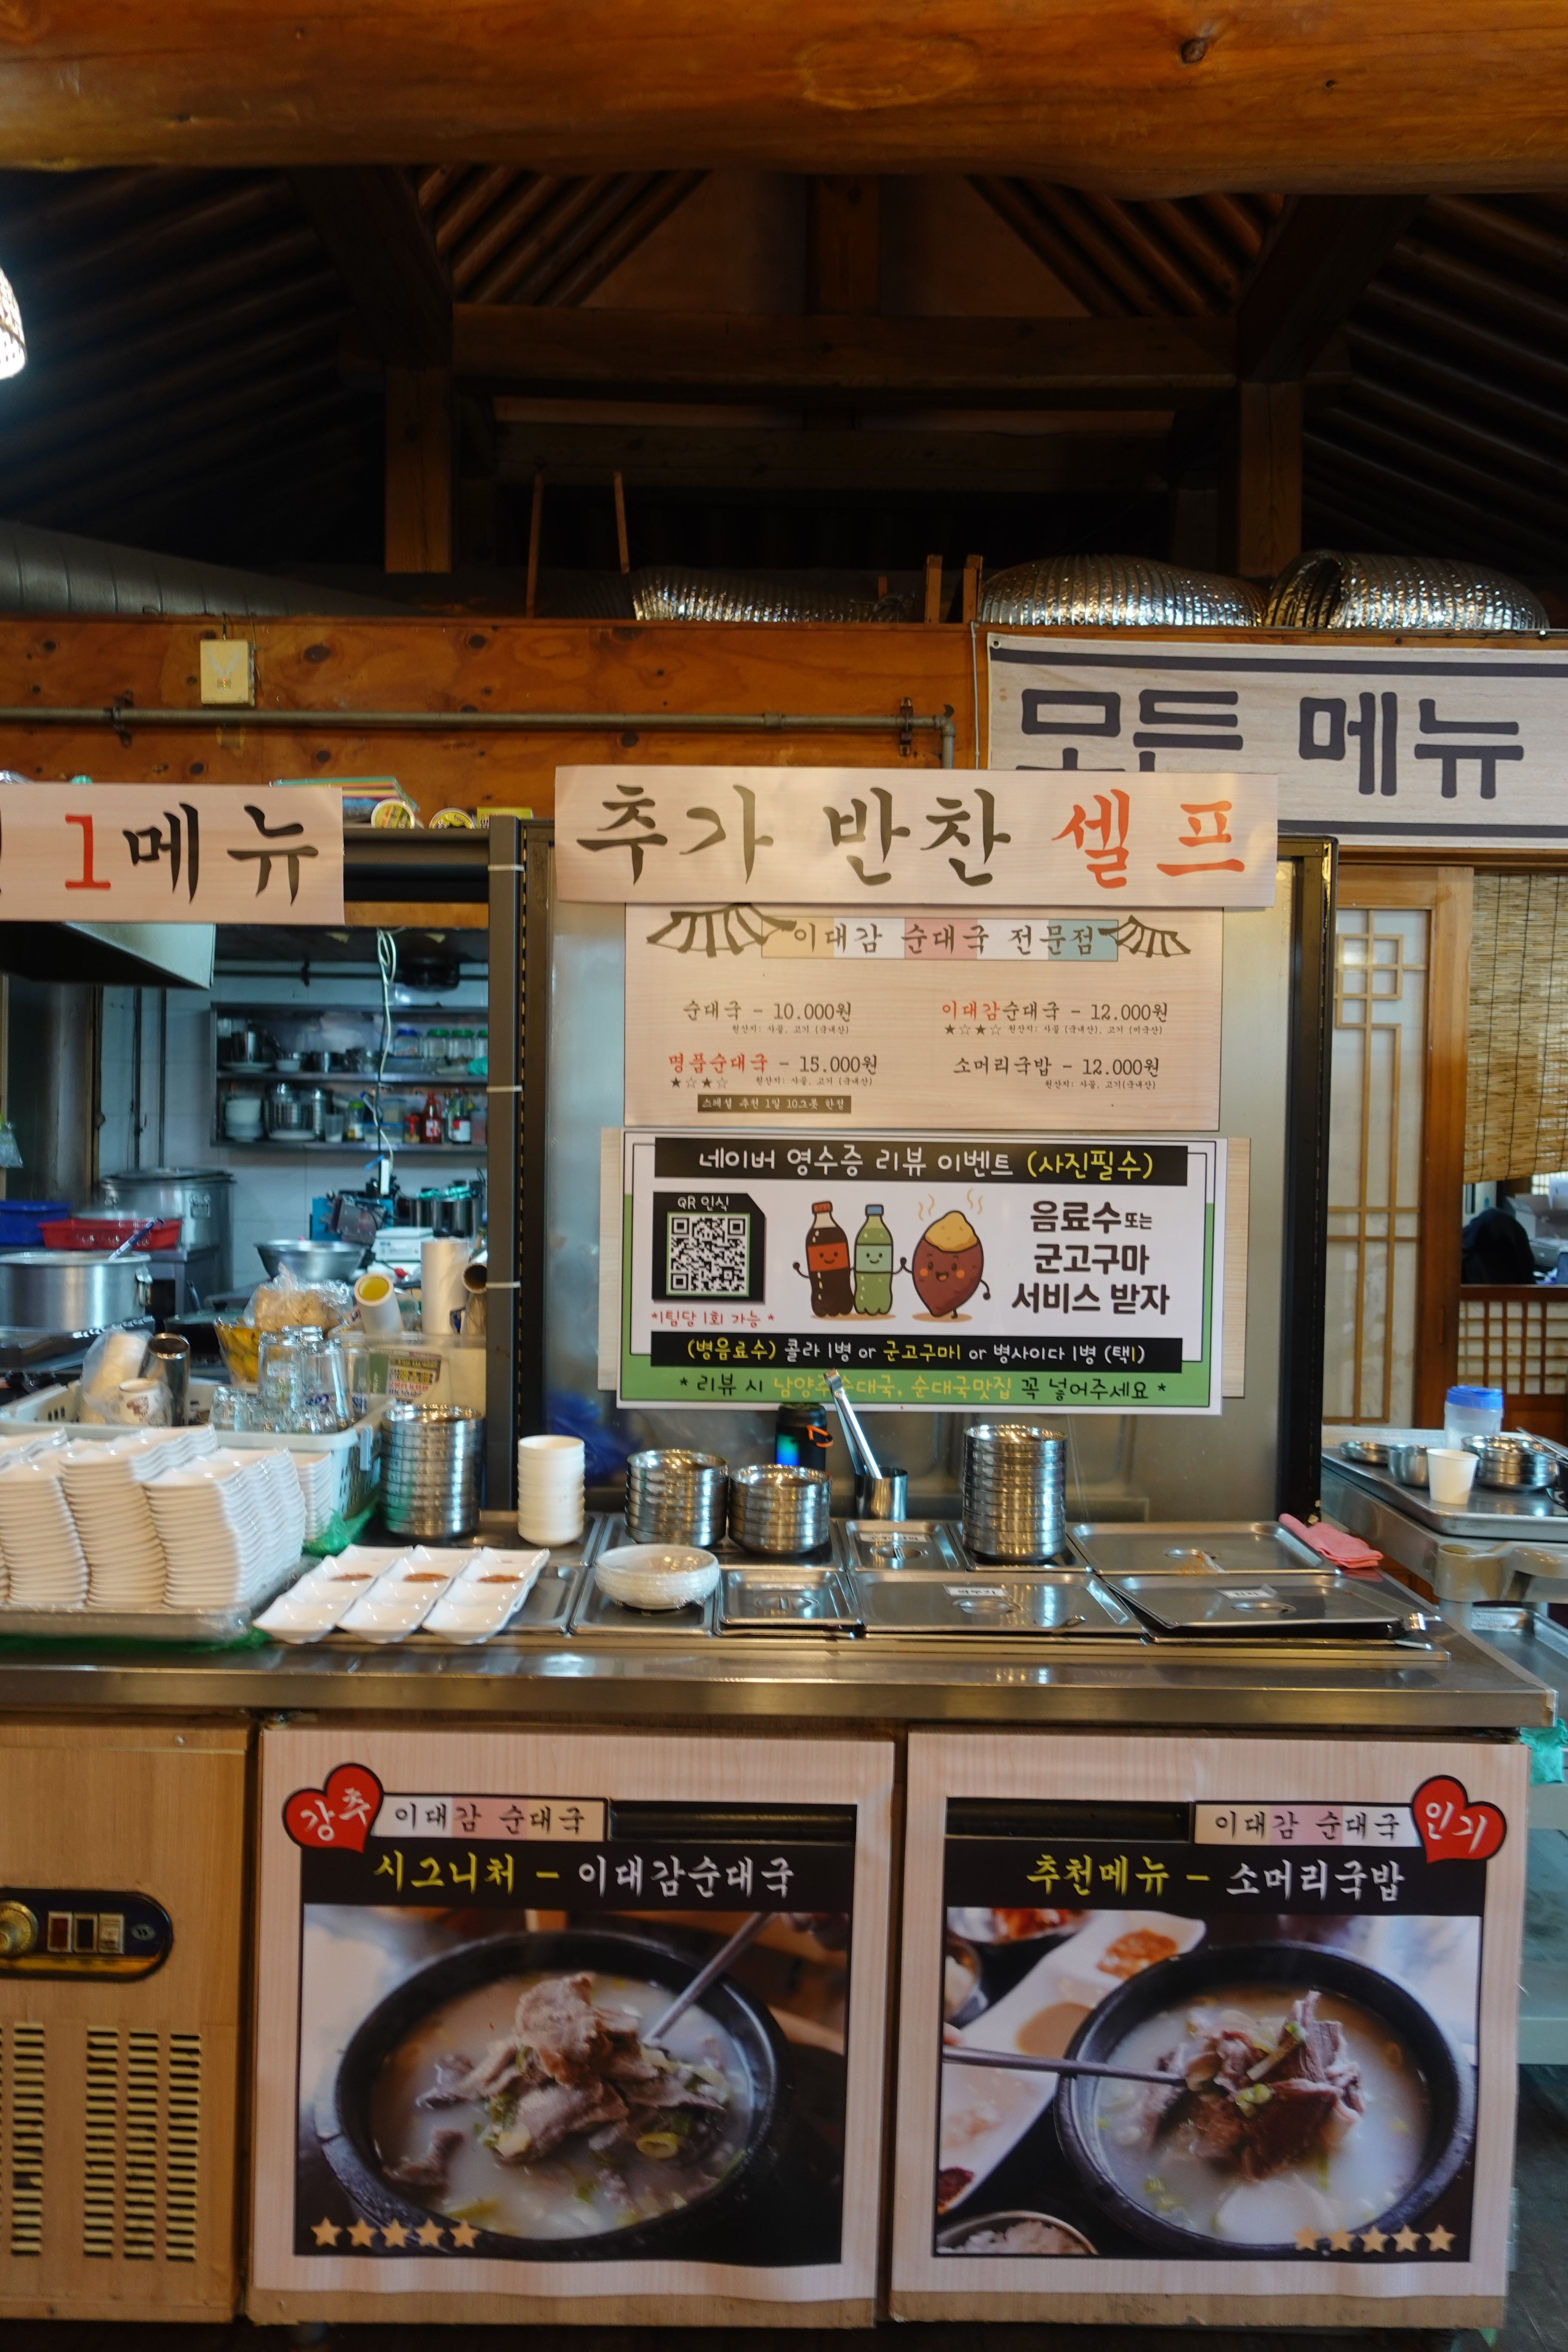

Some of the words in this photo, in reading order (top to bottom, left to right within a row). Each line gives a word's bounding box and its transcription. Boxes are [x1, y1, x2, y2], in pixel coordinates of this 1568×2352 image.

[1296, 690, 1526, 800] 메뉴
[576, 783, 775, 886] 추가
[823, 787, 1012, 887] 반찬
[1051, 787, 1246, 890] 셀프
[793, 922, 882, 954] 이대감
[901, 923, 989, 955] 순대국
[1007, 924, 1094, 956] 전문점
[683, 999, 742, 1021] 순대국
[773, 1001, 852, 1023] 10.000원
[942, 999, 1060, 1022] 이대감순대국
[1090, 1001, 1168, 1023] 12.000원
[668, 1052, 768, 1075] 명품순대국
[799, 1054, 878, 1075] 15.000원
[952, 1055, 1052, 1077] 소머리국밥
[1082, 1057, 1159, 1078] 12.000원
[698, 1146, 775, 1170] 네이버
[786, 1144, 864, 1178] 영수증
[875, 1145, 927, 1177] 리뷰
[937, 1150, 1014, 1179] 이벤트
[1026, 1150, 1154, 1181] (사진필수)
[677, 1194, 695, 1209] QR
[701, 1195, 729, 1211] 인식
[1030, 1200, 1122, 1234] 음료수
[1125, 1212, 1153, 1230] 또는
[1034, 1243, 1150, 1276] 군고구마
[1011, 1283, 1101, 1314] 서비스
[1110, 1283, 1170, 1315] 받자
[731, 1310, 761, 1328] 가능
[688, 1336, 776, 1362] (병음료수)
[784, 1338, 820, 1363] 콜라
[859, 1347, 876, 1359] or
[969, 1348, 987, 1360] or
[993, 1344, 1065, 1365] 병사이다
[697, 1373, 737, 1396] 리뷰
[745, 1379, 763, 1393] 시
[910, 1375, 1012, 1400] 순대국맛집
[1021, 1378, 1040, 1400] 꼭
[1049, 1378, 1148, 1401] 넣어주세요
[301, 1787, 371, 1841] 강추
[395, 1802, 481, 1833] 이대감
[499, 1803, 585, 1835] 순대국
[1215, 1810, 1300, 1840] 이대감
[1315, 1810, 1400, 1840] 순대국
[1425, 1801, 1488, 1853] 인기
[374, 1850, 515, 1895] 시그니처
[579, 1854, 794, 1899] 이대감순대국
[1026, 1853, 1170, 1896] 추천메뉴
[1226, 1859, 1405, 1902] 소머리국밥
